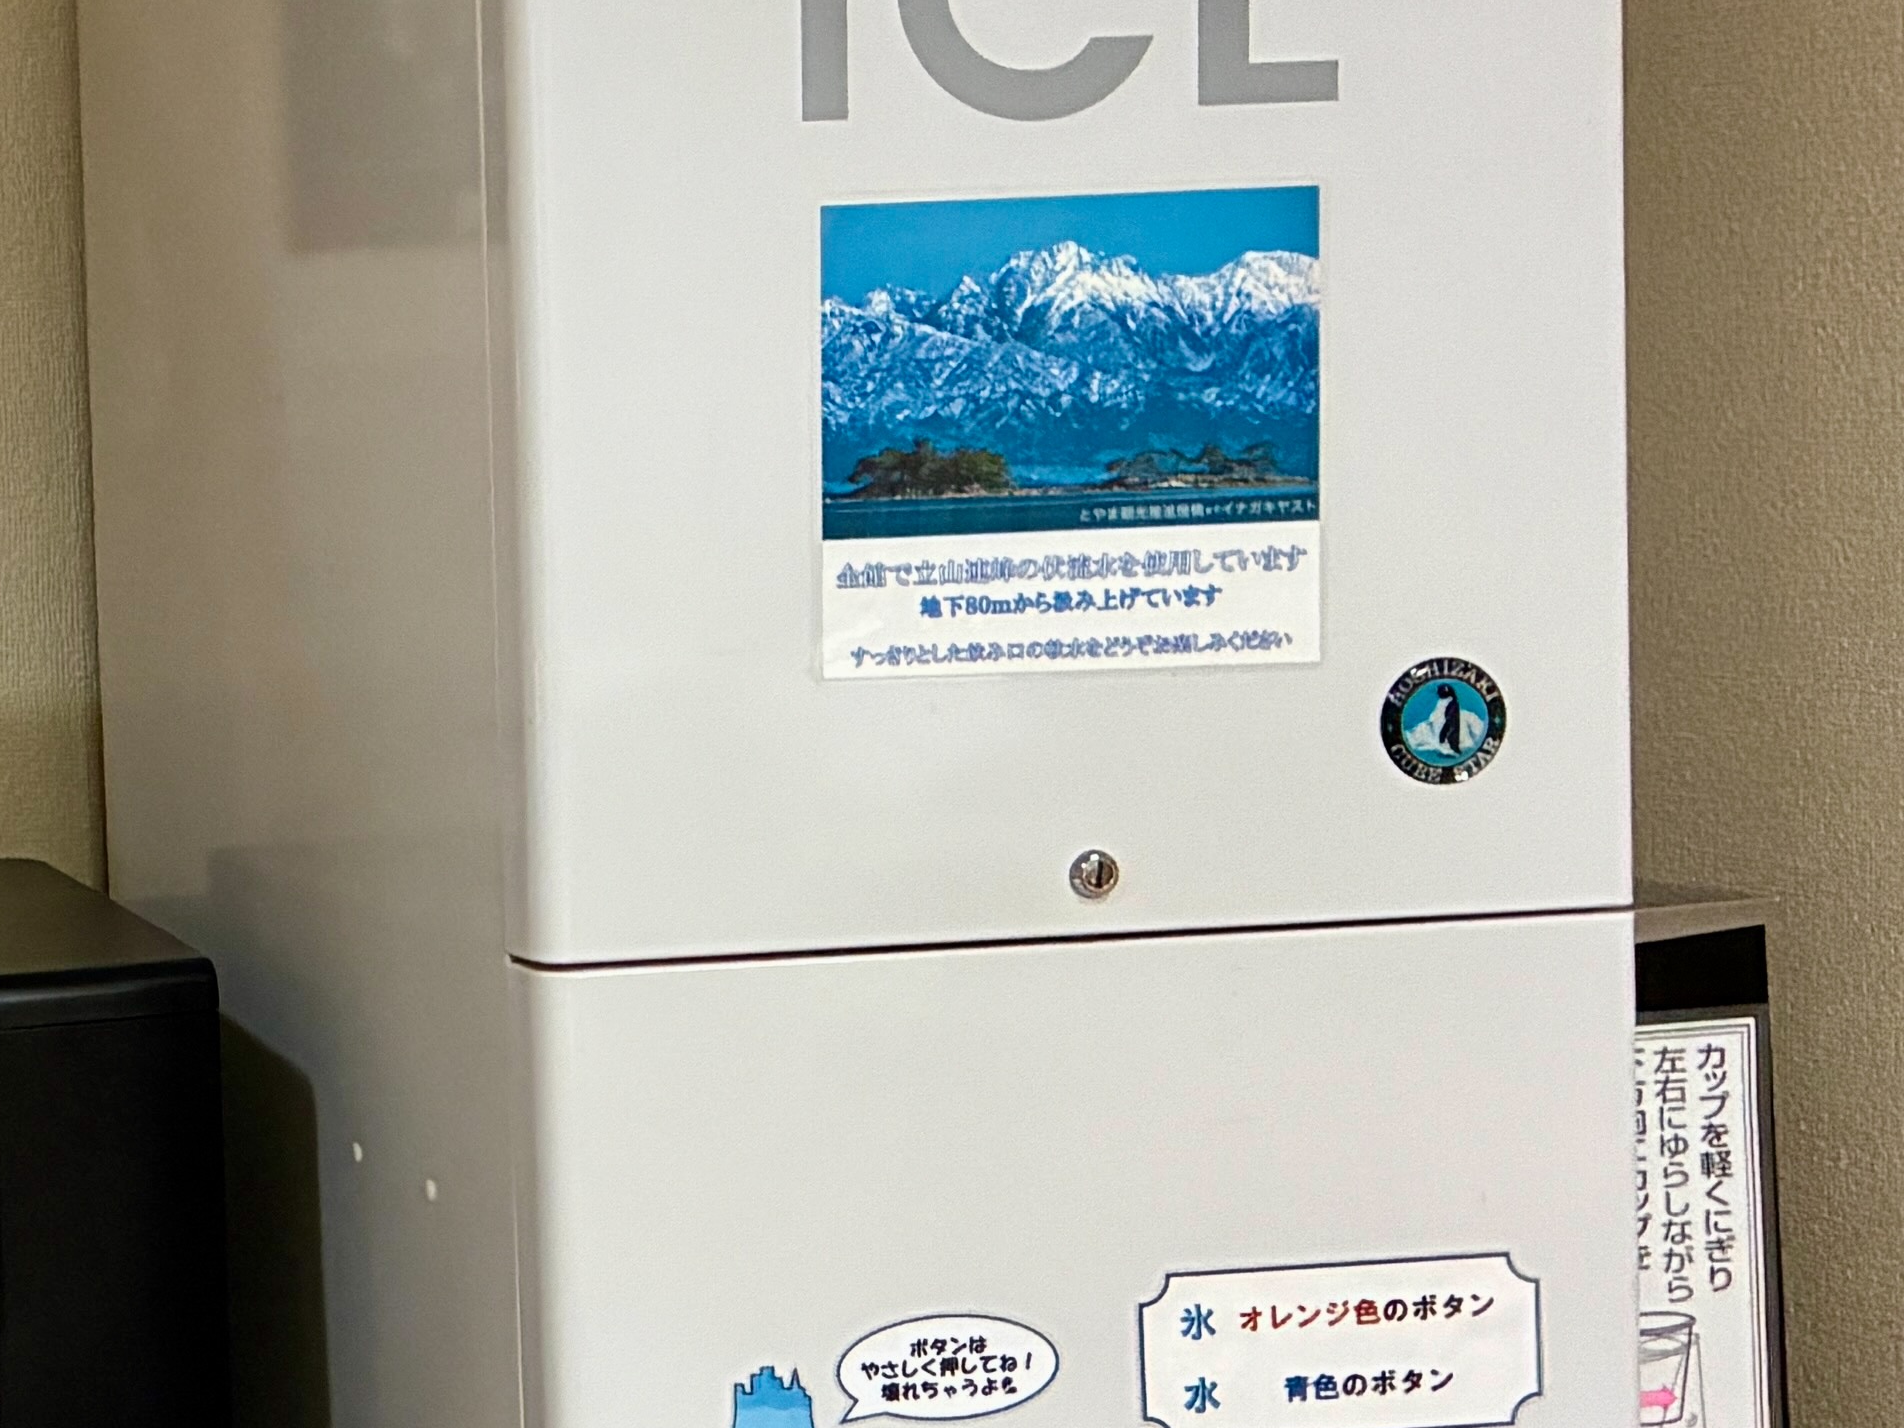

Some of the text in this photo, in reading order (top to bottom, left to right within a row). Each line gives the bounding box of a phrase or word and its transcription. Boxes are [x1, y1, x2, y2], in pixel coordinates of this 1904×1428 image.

[919, 584, 1223, 619] 地下80mから汲み上げています
[1653, 1045, 1695, 1303] 左右にゆらしながら
[1697, 1043, 1735, 1293] カップを軽くにぎり
[1180, 1293, 1495, 1341] 氷 オレンジ色のボタン
[910, 1335, 988, 1358] ボタンは
[1184, 1369, 1455, 1414] 水 青色のボタン
